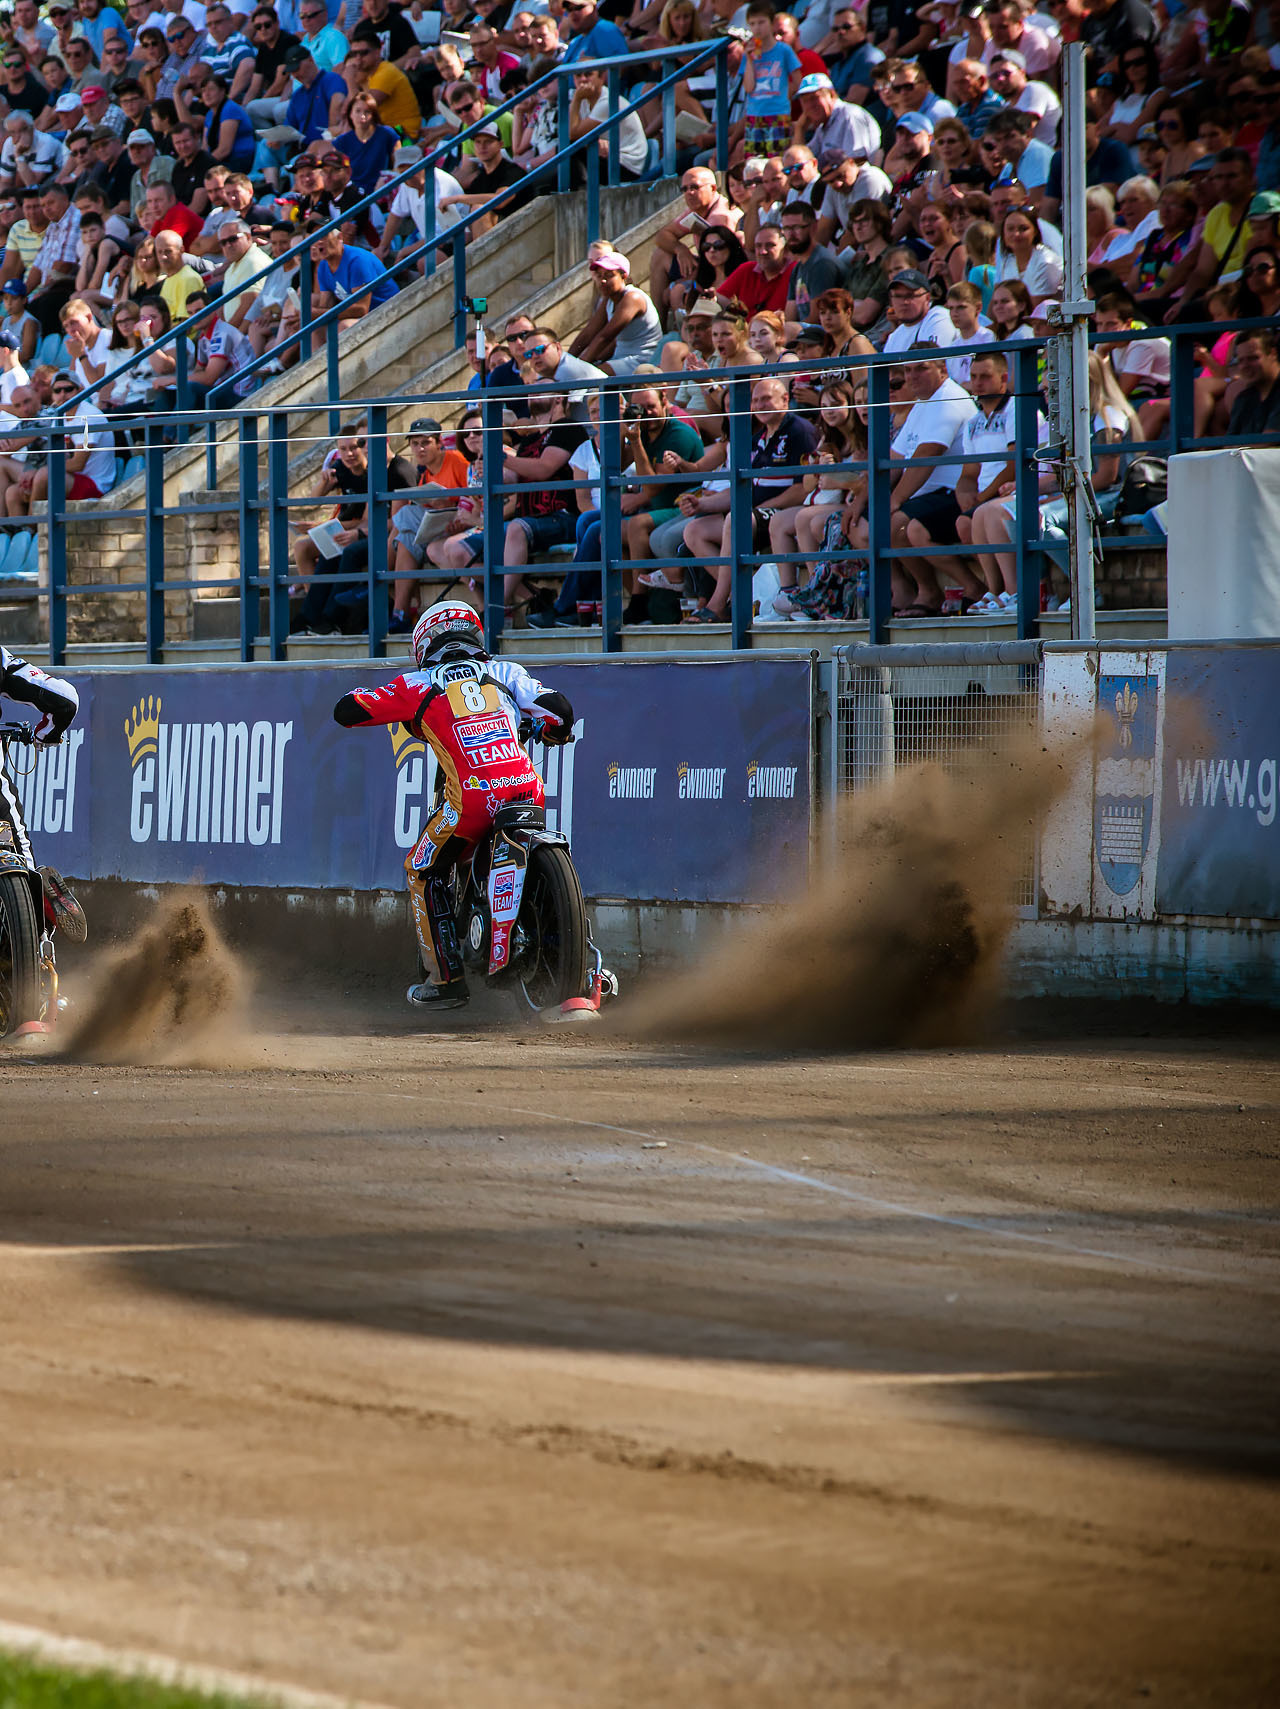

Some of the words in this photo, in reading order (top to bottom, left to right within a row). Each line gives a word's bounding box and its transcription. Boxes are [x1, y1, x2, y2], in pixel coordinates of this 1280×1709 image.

[460, 680, 487, 712] 8
[460, 718, 508, 738] ABRAMCZYK
[466, 741, 519, 765] TEAM
